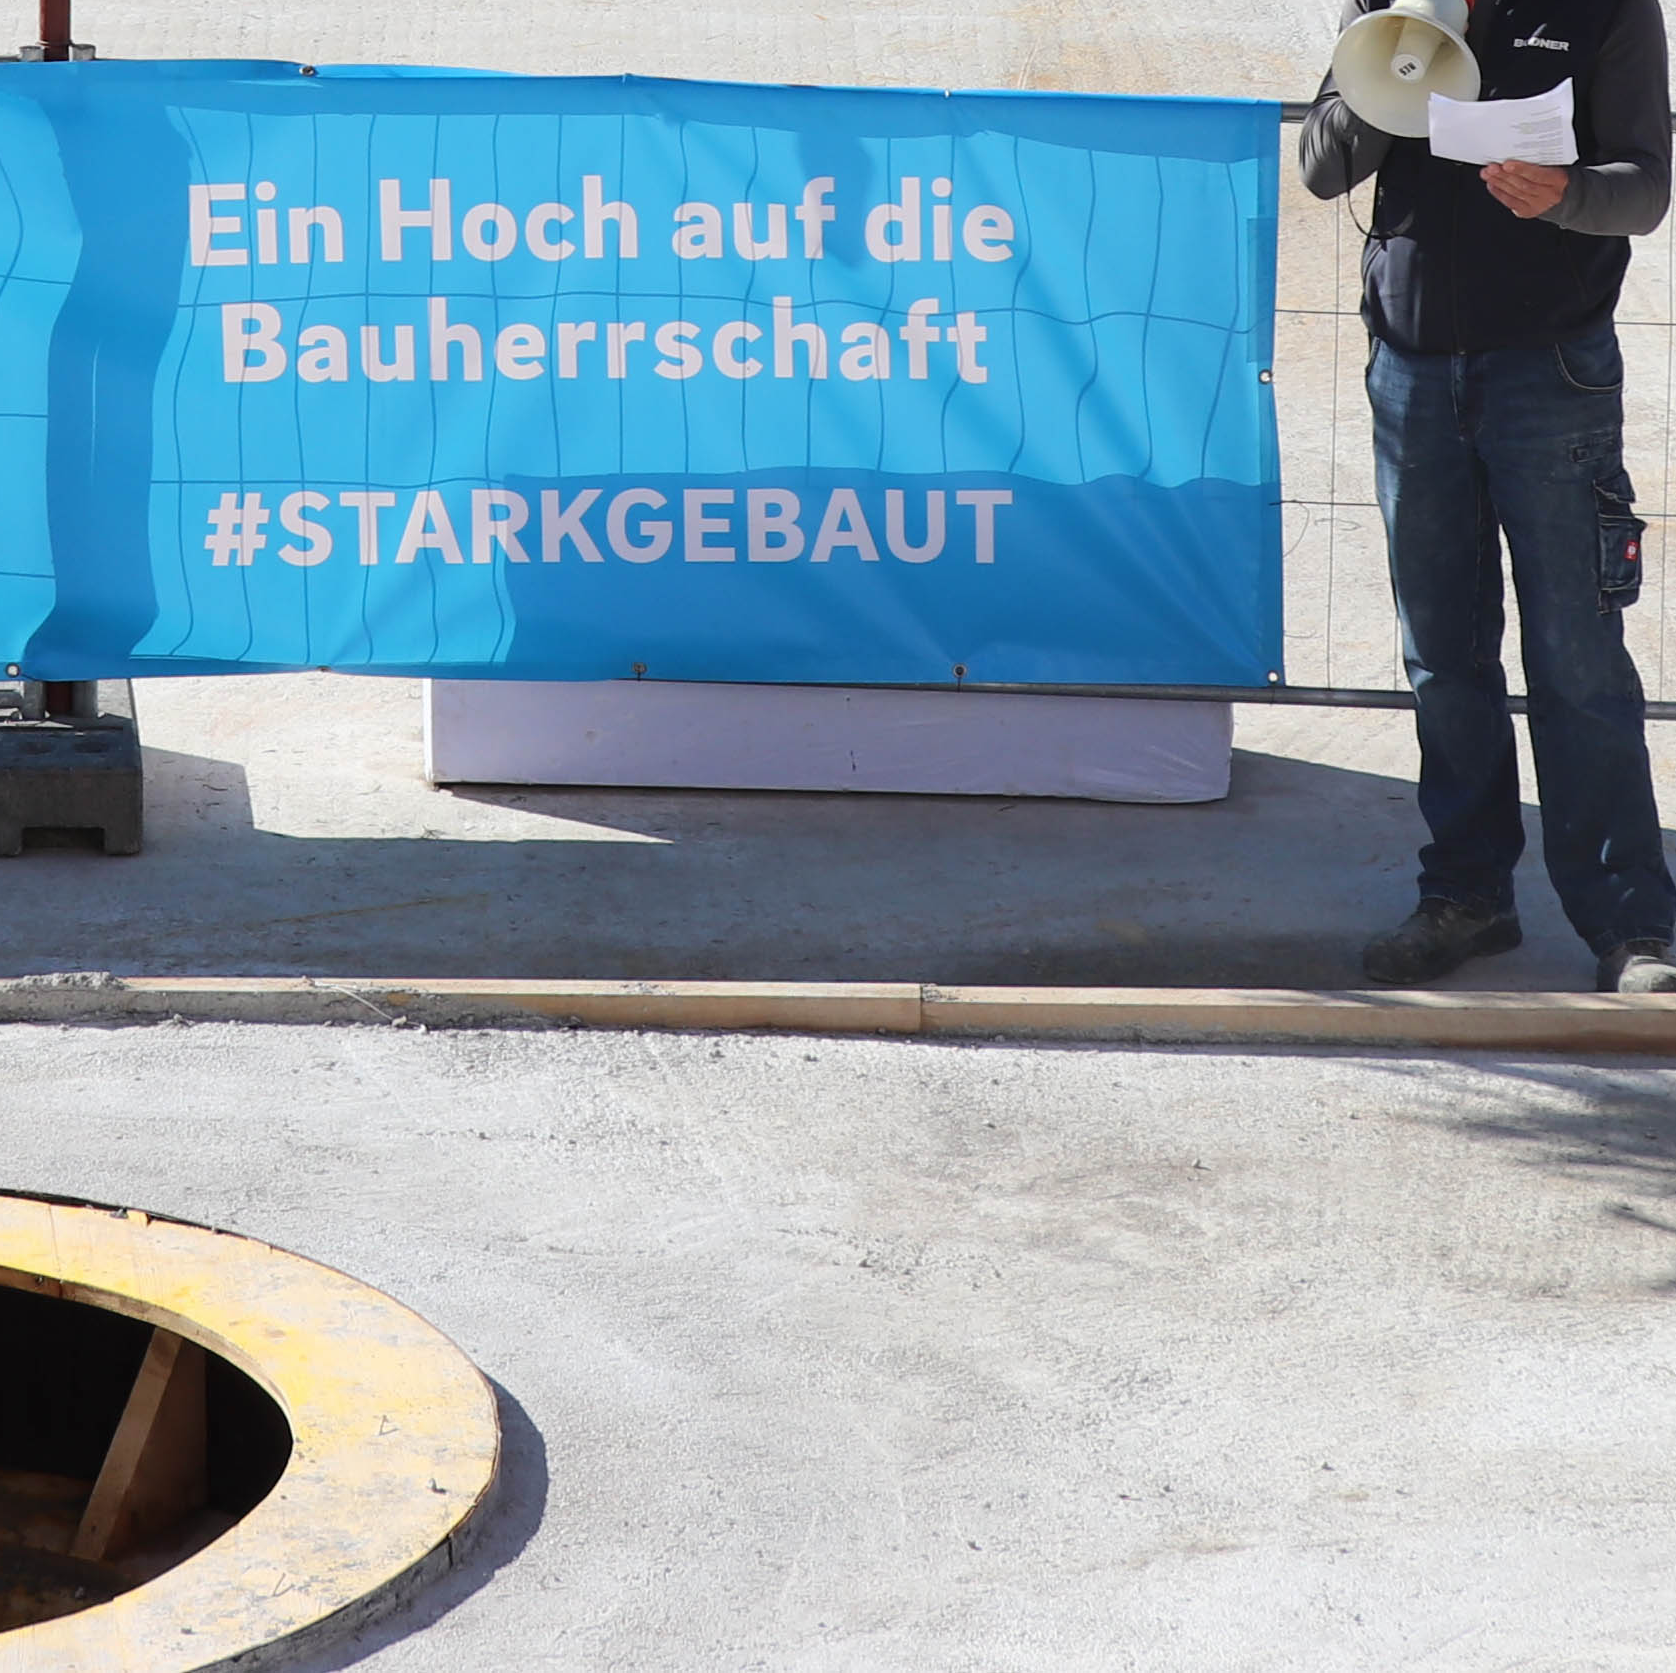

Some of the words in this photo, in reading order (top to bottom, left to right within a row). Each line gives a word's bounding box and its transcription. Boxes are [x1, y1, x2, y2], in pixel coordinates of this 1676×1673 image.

[189, 182, 344, 267] Ein
[380, 176, 638, 262] Hoch
[673, 178, 835, 261] auf
[865, 177, 1014, 263] die
[221, 297, 988, 384] Bauherrschaft
[204, 487, 1013, 567] #STARKGEBAUT
